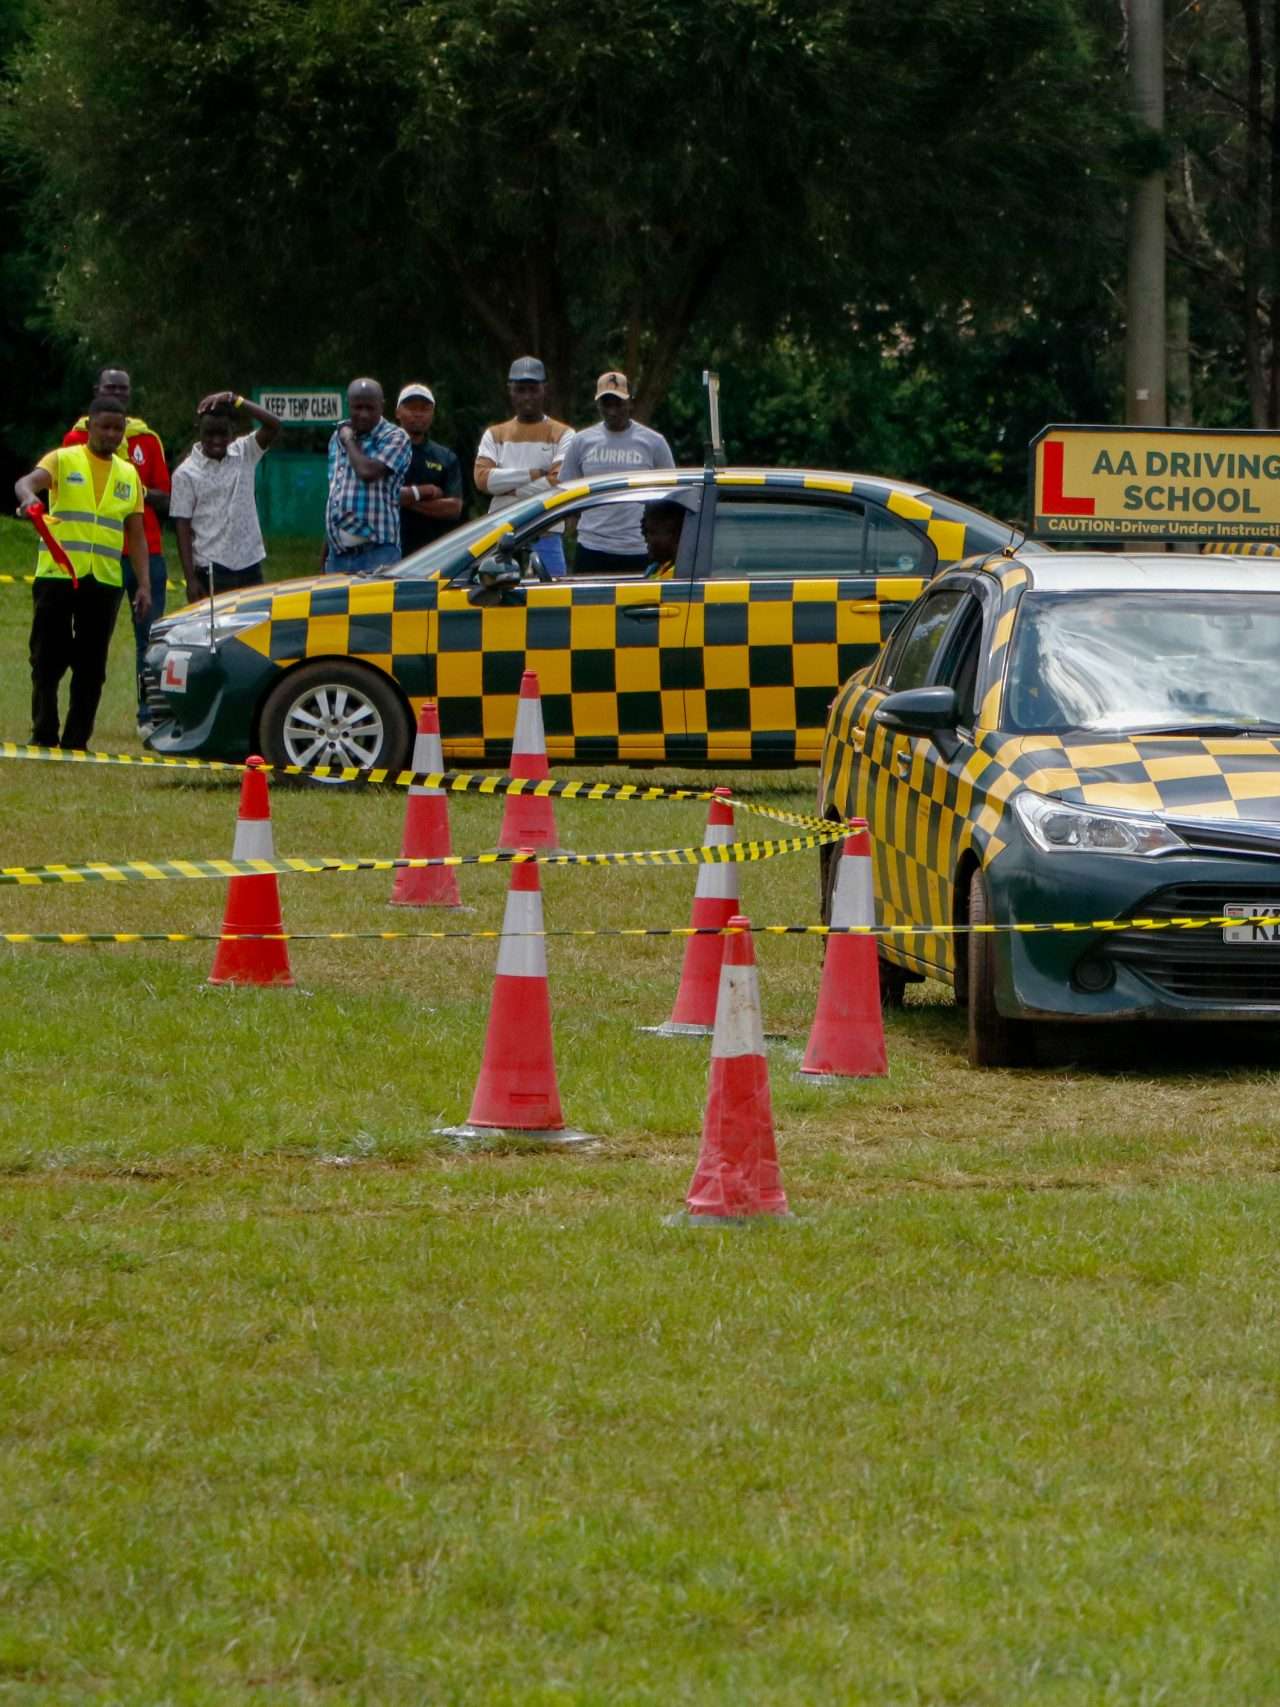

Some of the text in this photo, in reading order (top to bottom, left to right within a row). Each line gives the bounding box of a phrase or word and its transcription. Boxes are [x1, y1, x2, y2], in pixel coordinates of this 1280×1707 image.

[311, 397, 338, 417] CLEAN
[1092, 450, 1137, 476] AA
[1042, 441, 1095, 515] L
[1123, 485, 1260, 514] SCHOOL
[1048, 519, 1165, 534] CAUTION-Driver
[1169, 522, 1213, 535] Under
[166, 660, 184, 686] L
